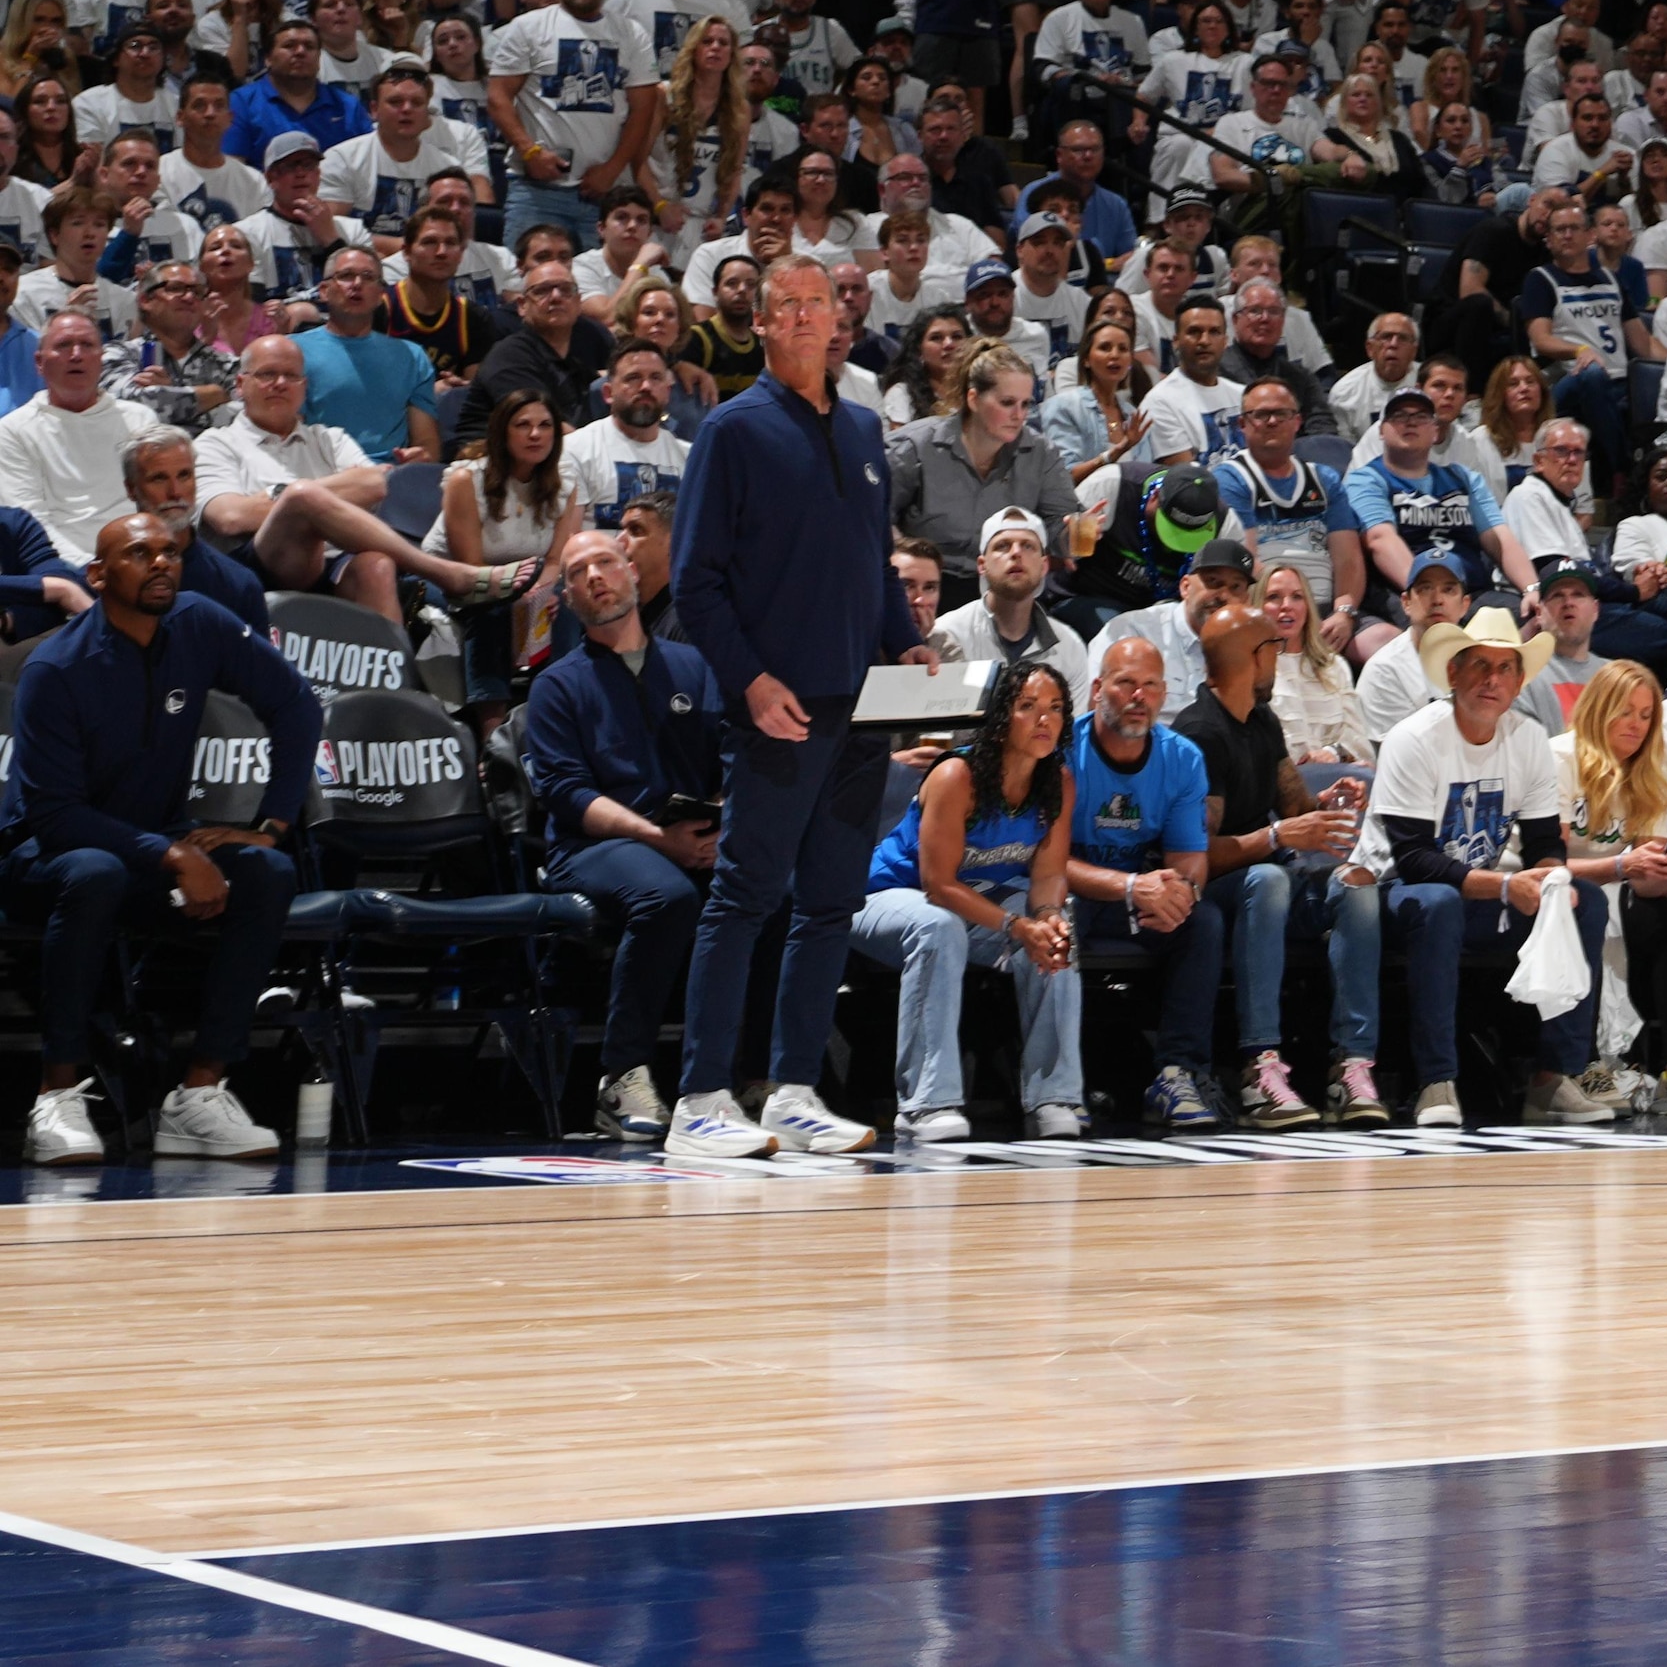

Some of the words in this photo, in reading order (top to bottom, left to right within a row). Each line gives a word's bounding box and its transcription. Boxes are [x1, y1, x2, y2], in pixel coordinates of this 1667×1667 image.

[1598, 325, 1618, 354] 5
[284, 630, 405, 692] PLAYOFFS
[337, 736, 466, 790] PLAYOFFS
[354, 787, 405, 808] Google
